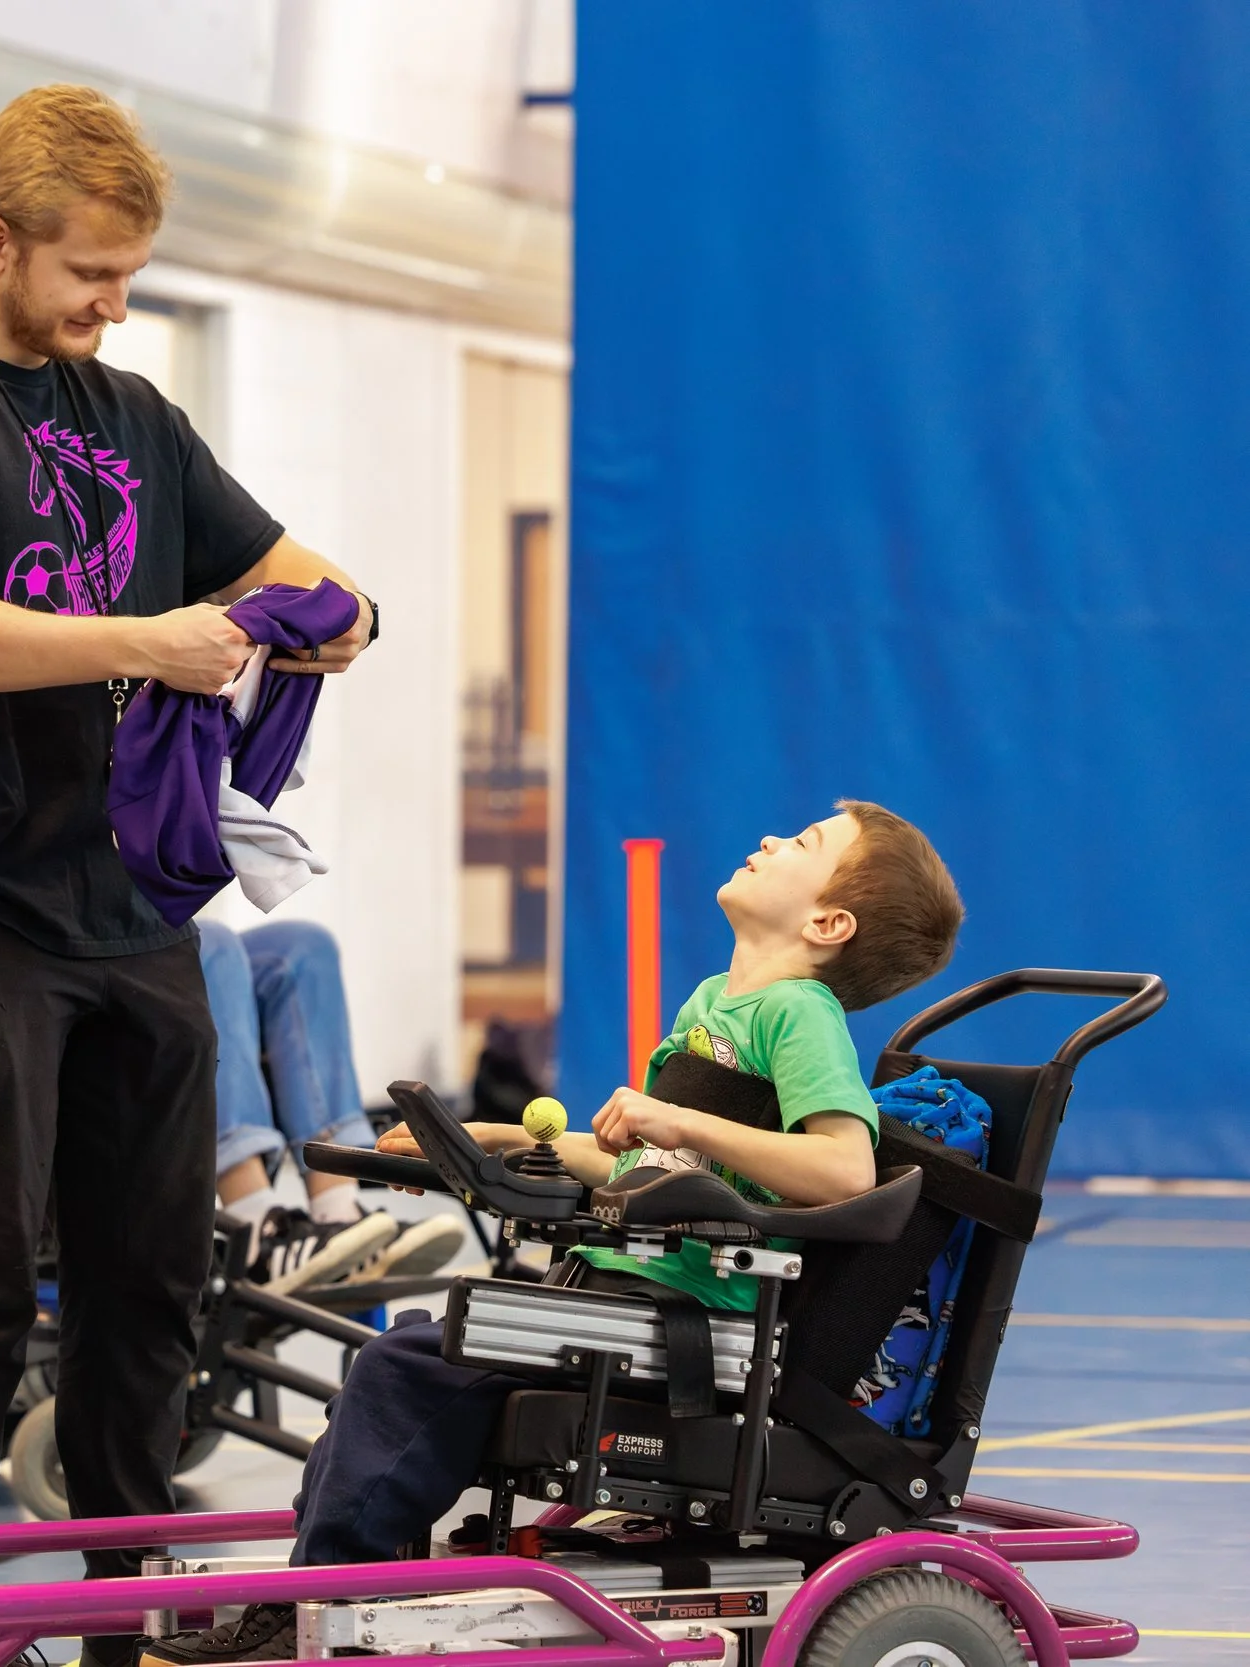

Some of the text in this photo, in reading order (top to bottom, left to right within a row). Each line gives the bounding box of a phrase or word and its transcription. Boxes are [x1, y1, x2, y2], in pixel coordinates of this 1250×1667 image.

[88, 511, 126, 559] LETRIDGE
[618, 1434, 664, 1448] EXPRESS
[616, 1444, 663, 1456] COMFORT
[613, 1600, 717, 1618] RIKE FORCE
